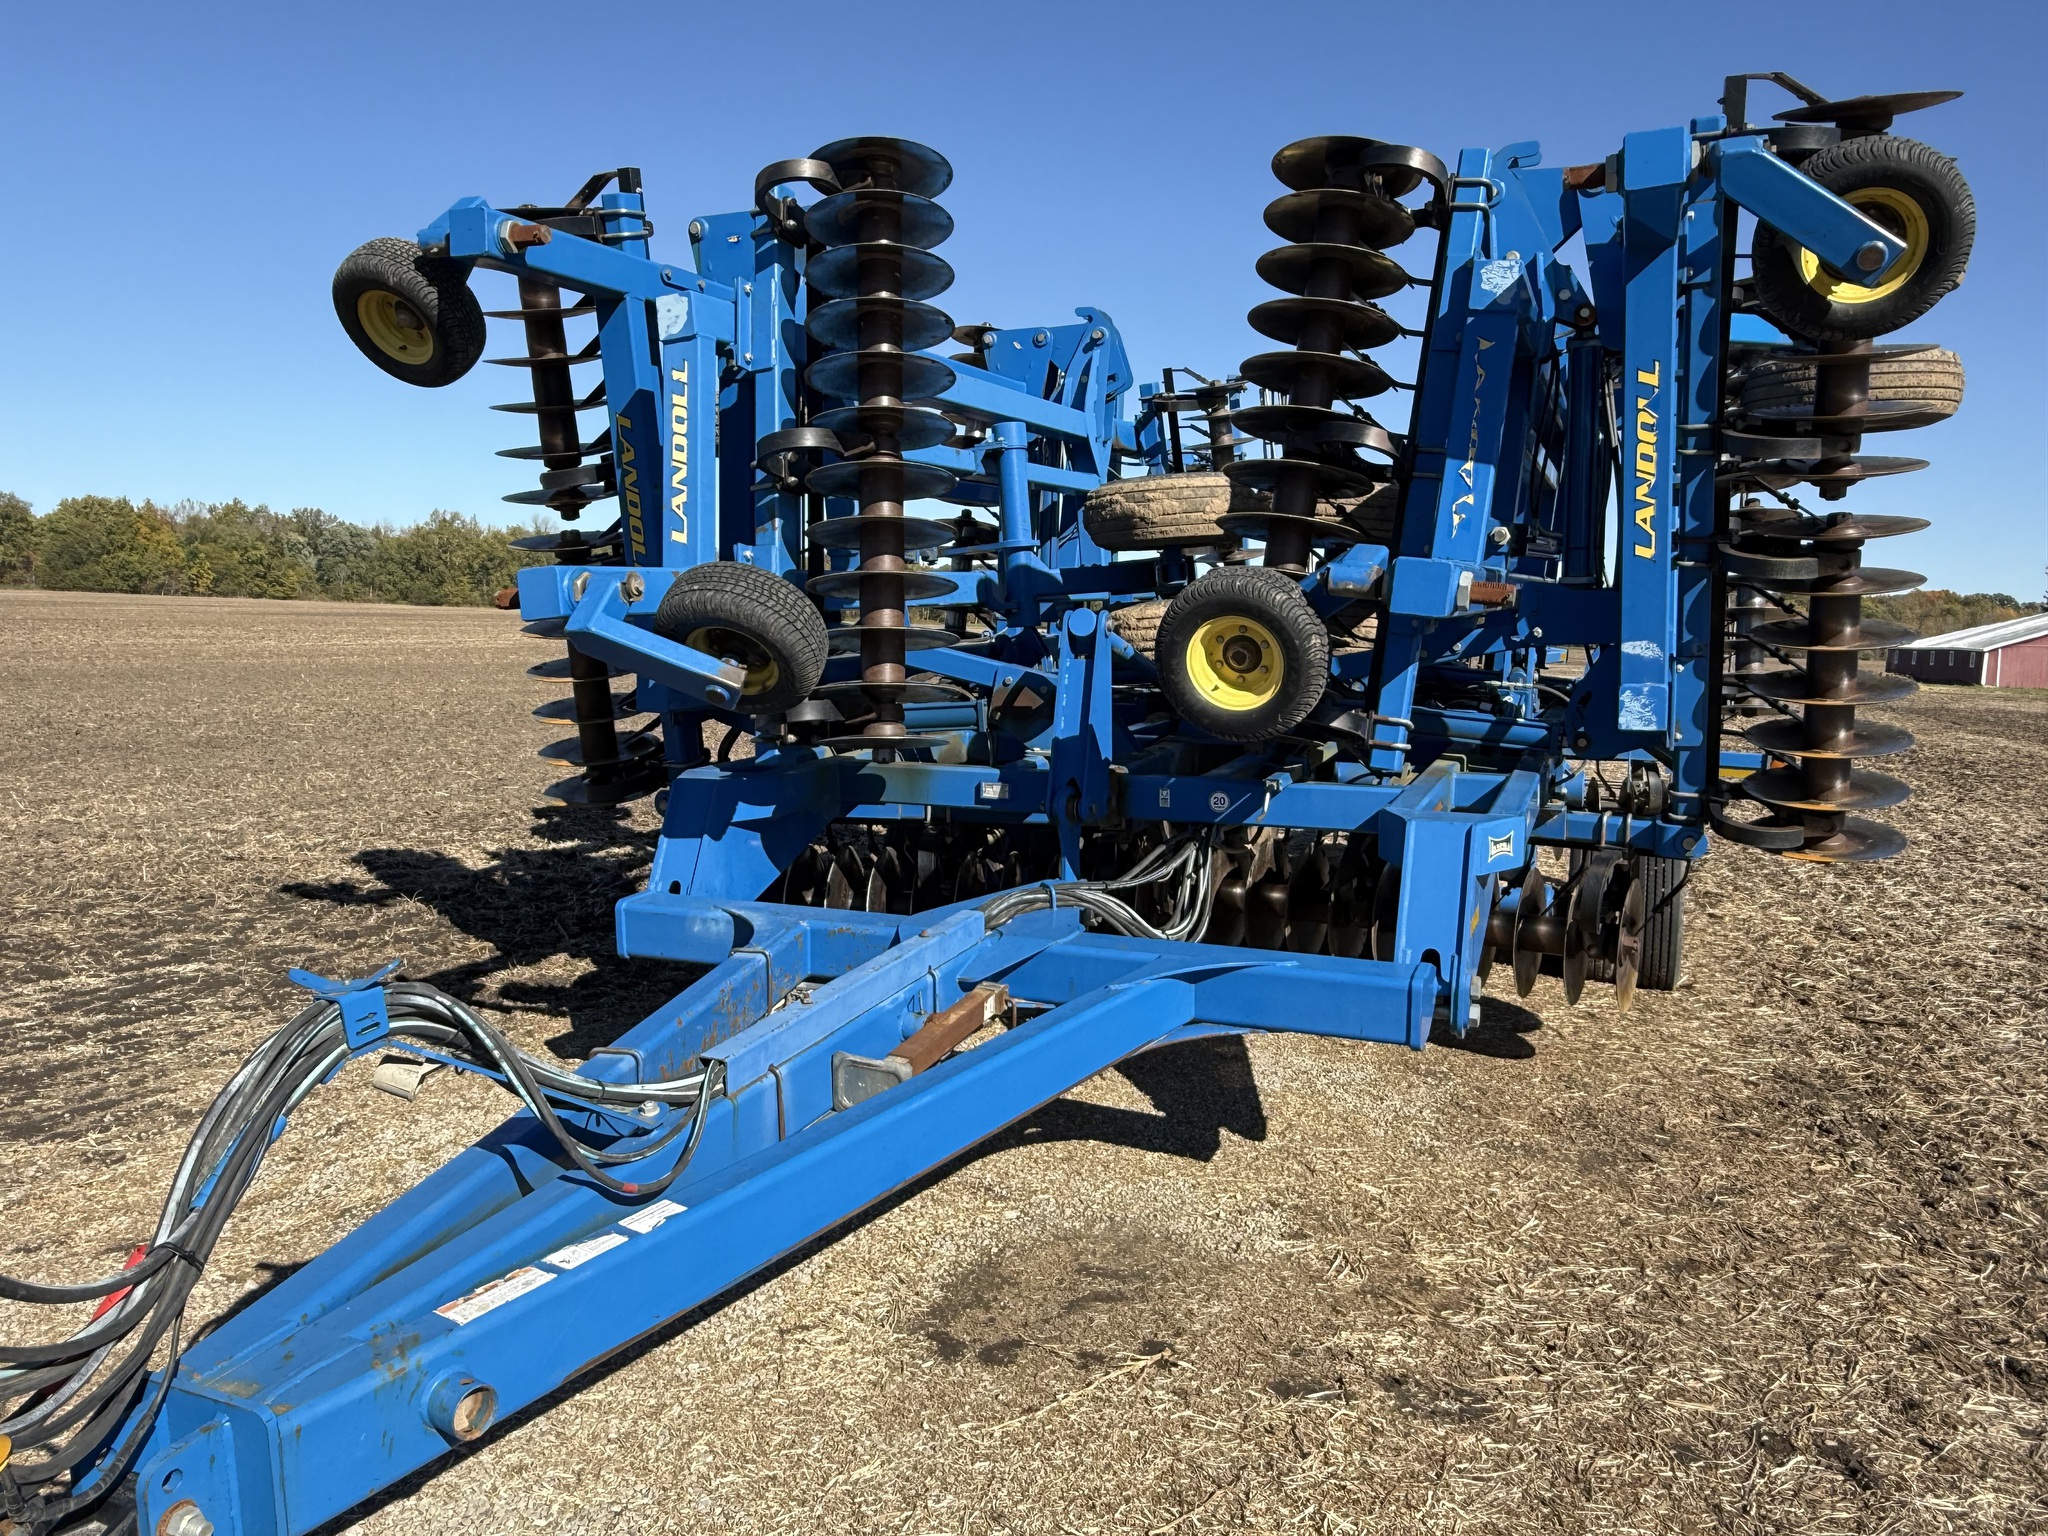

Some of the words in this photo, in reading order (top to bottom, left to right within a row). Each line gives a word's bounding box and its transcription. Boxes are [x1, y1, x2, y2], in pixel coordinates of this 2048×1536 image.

[616, 413, 646, 567] LANDOL
[671, 359, 689, 544] LANDOLL
[1213, 796, 1226, 806] 20
